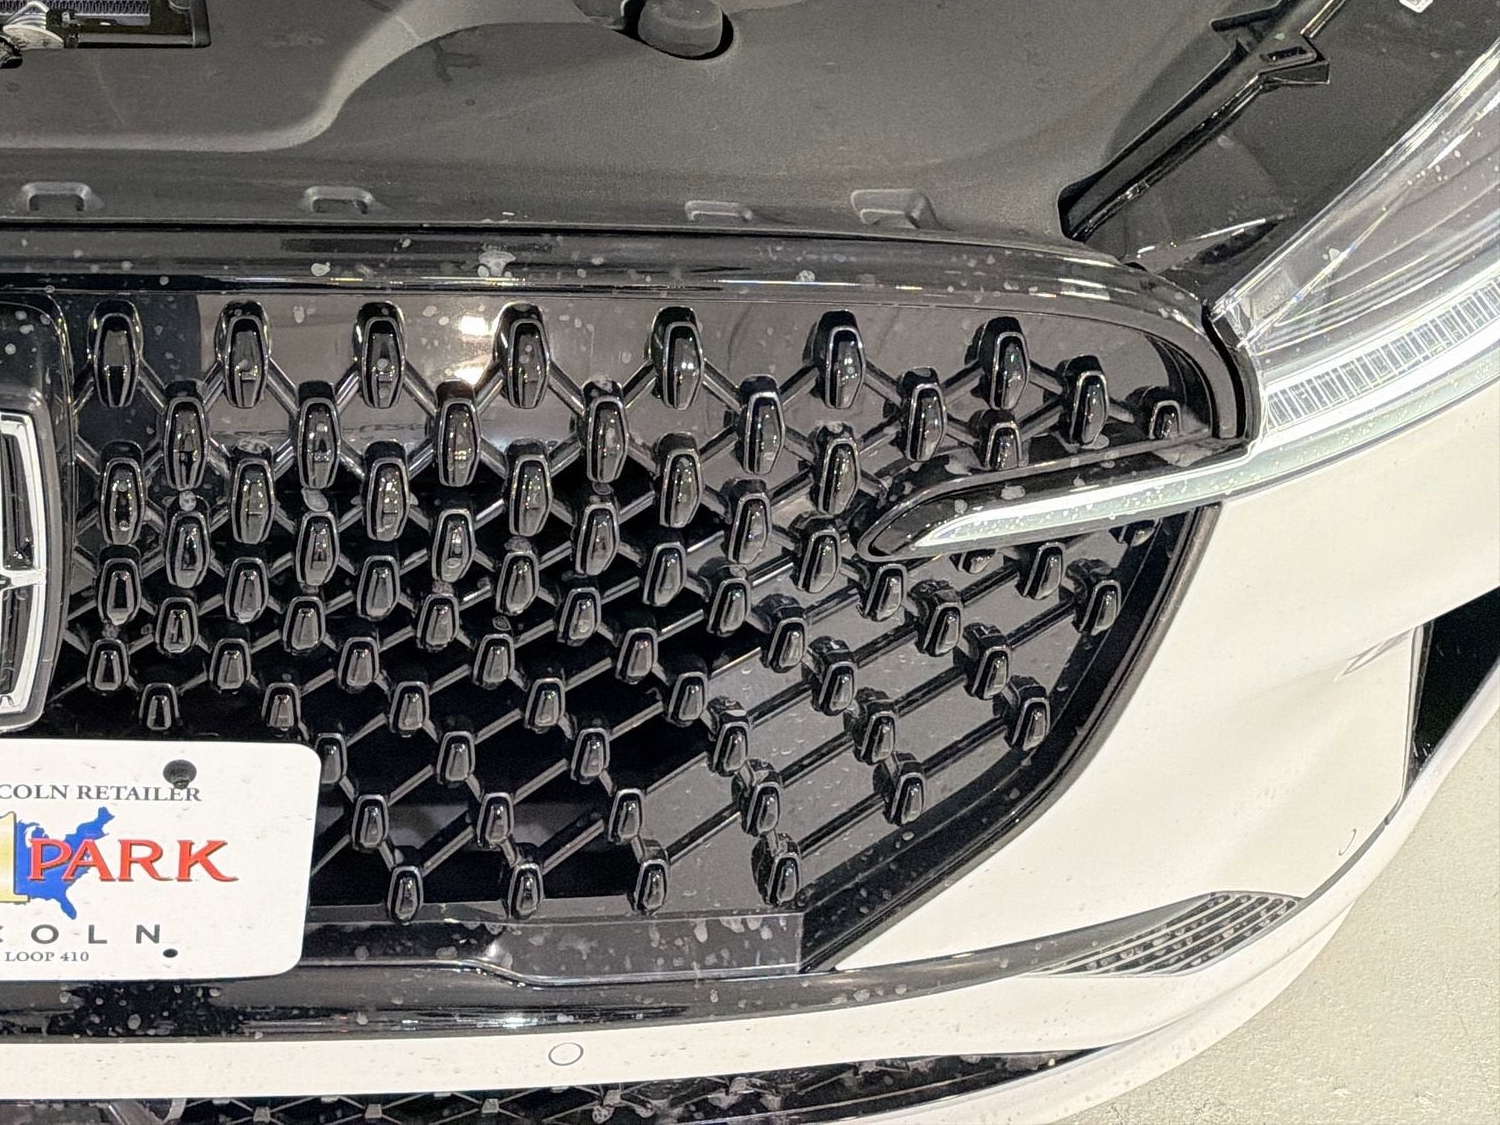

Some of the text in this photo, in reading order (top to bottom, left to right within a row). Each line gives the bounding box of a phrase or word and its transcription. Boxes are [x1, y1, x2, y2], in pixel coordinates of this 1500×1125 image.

[75, 785, 202, 802] RETAILER
[28, 838, 239, 883] PARK
[5, 951, 55, 963] LOOP
[59, 950, 90, 963] 410
